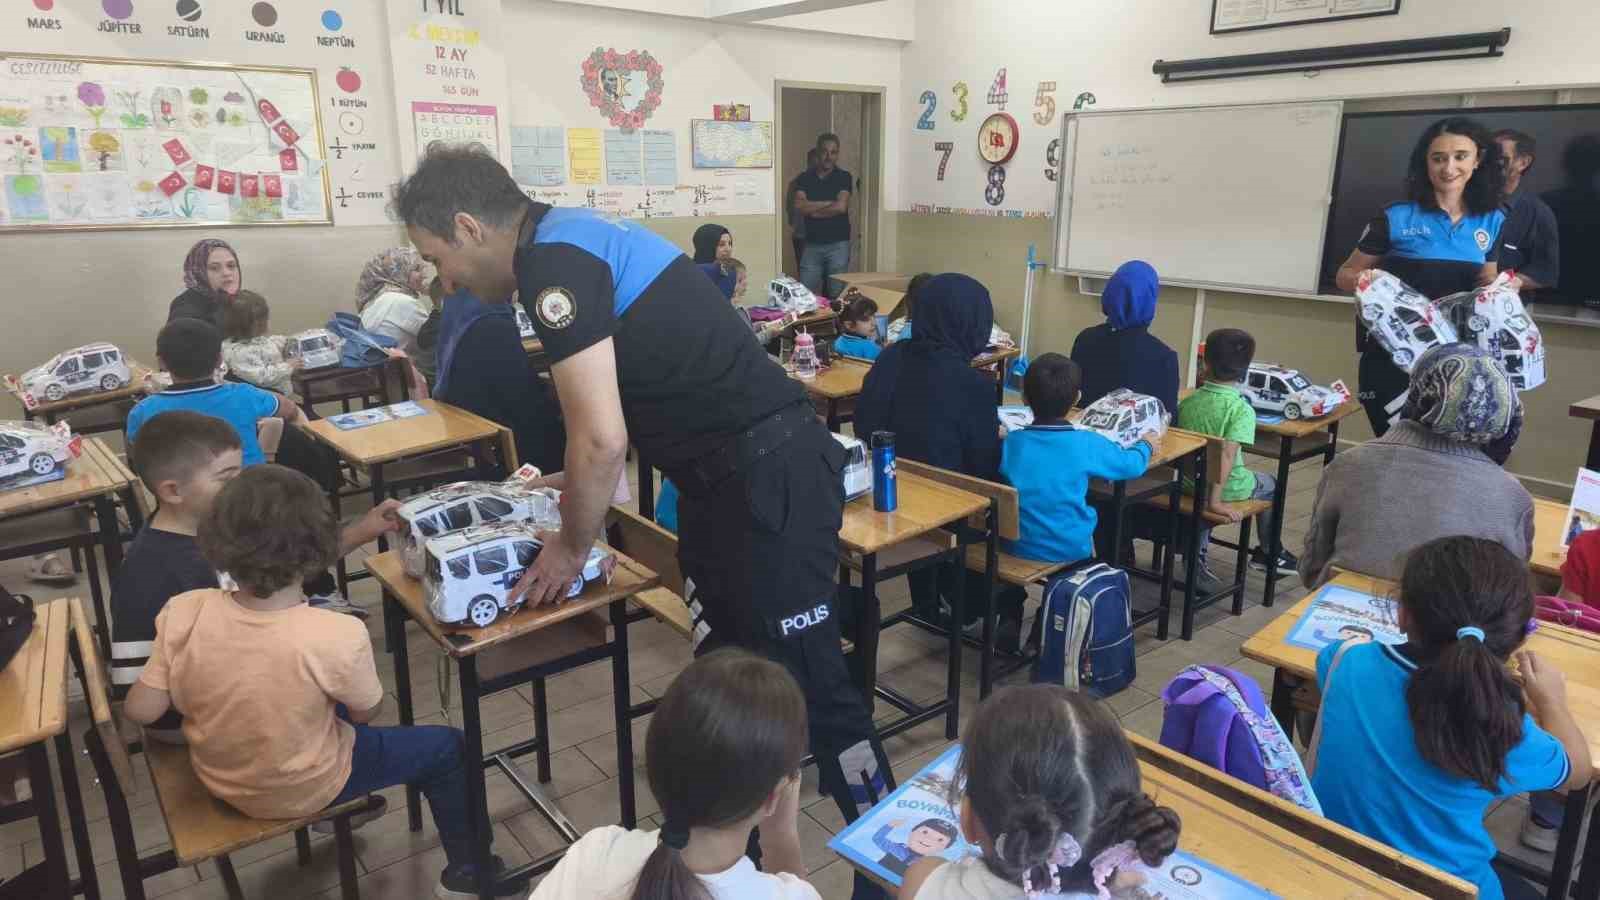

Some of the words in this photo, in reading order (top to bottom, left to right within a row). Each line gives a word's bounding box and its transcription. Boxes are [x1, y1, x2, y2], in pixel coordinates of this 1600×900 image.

[27, 17, 62, 30] MARS
[97, 19, 142, 34] JÜPİTER
[166, 25, 210, 38] SATÜRN
[434, 45, 446, 59] 12
[450, 47, 467, 62] AY
[424, 64, 437, 75] 52
[440, 65, 476, 81] HAFTA
[987, 67, 1009, 111] 4
[917, 89, 937, 130] 2
[950, 80, 969, 122] 3
[1033, 81, 1057, 127] 5
[934, 142, 954, 181] 7
[985, 165, 1007, 206] 8
[781, 604, 830, 635] POLIS
